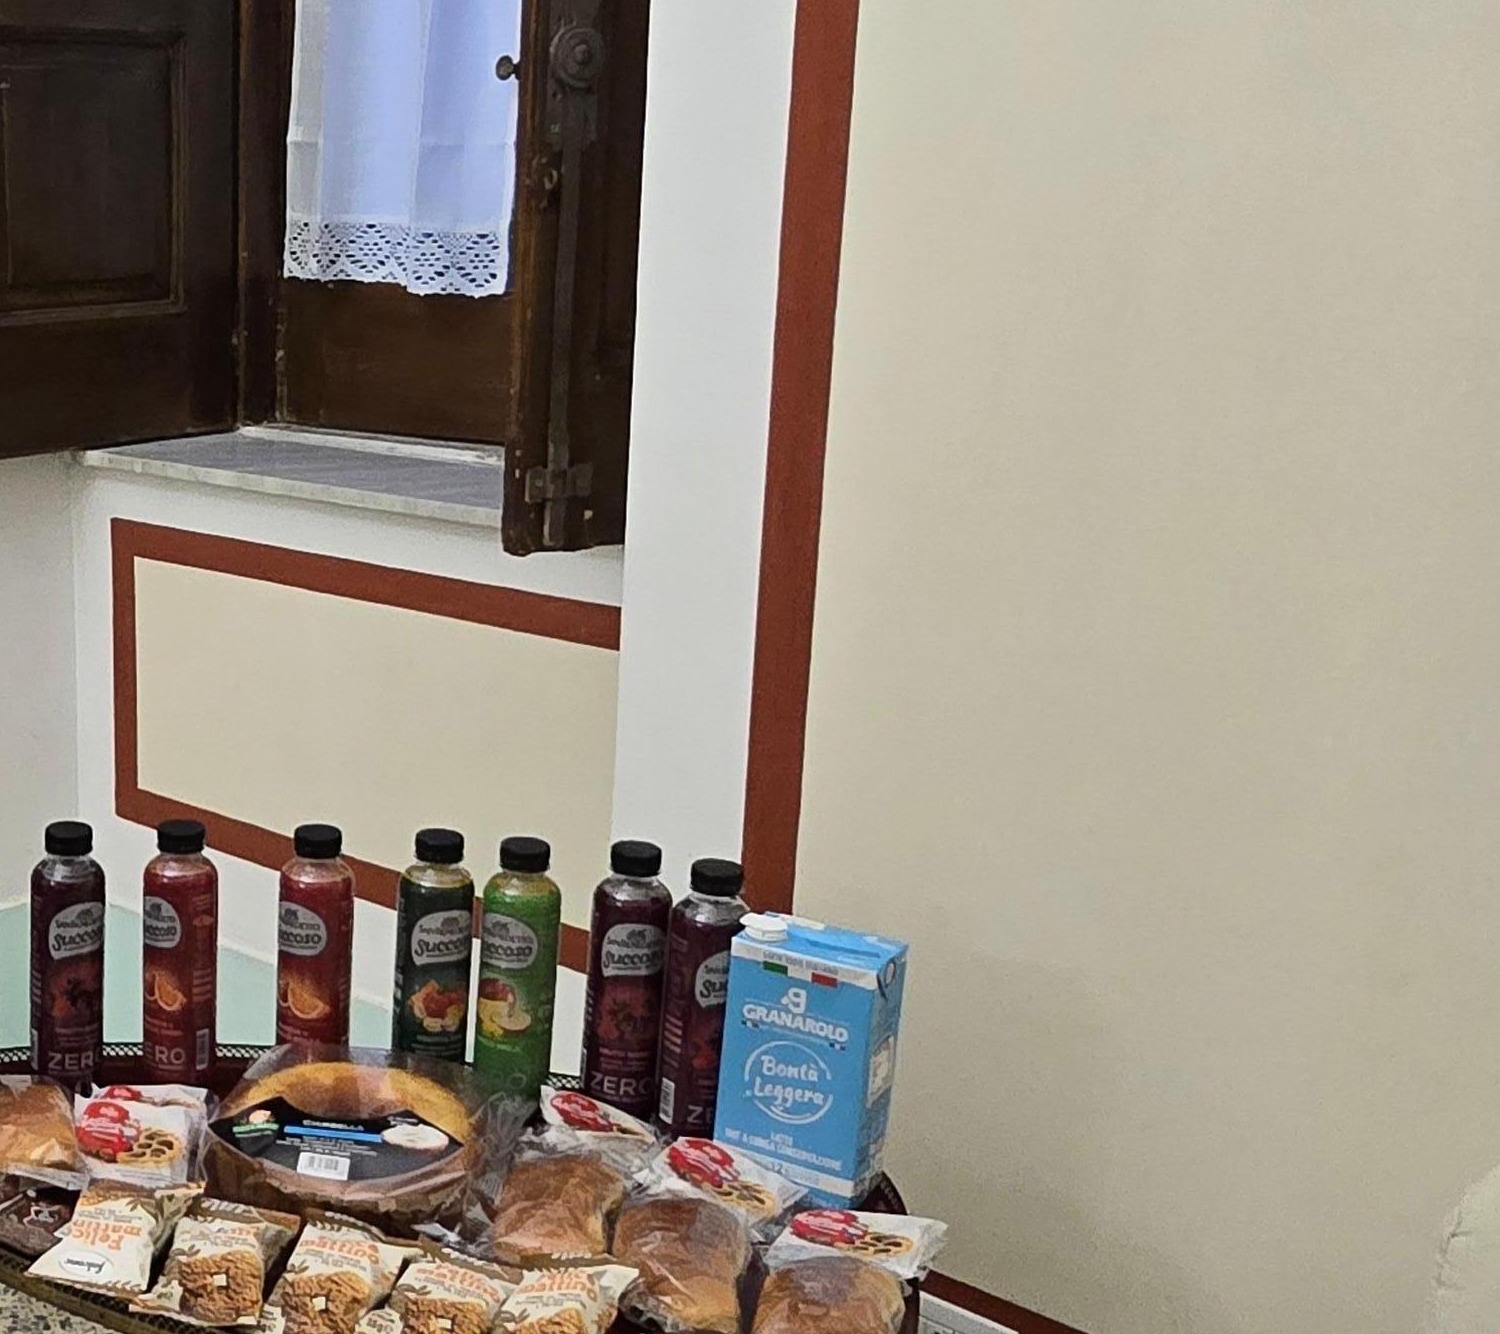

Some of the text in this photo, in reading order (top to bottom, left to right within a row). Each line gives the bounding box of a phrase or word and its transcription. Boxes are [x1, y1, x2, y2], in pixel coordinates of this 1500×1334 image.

[742, 1003, 849, 1043] GRANAROLO
[761, 1055, 818, 1082] Bontà
[754, 1076, 824, 1108] Leggera
